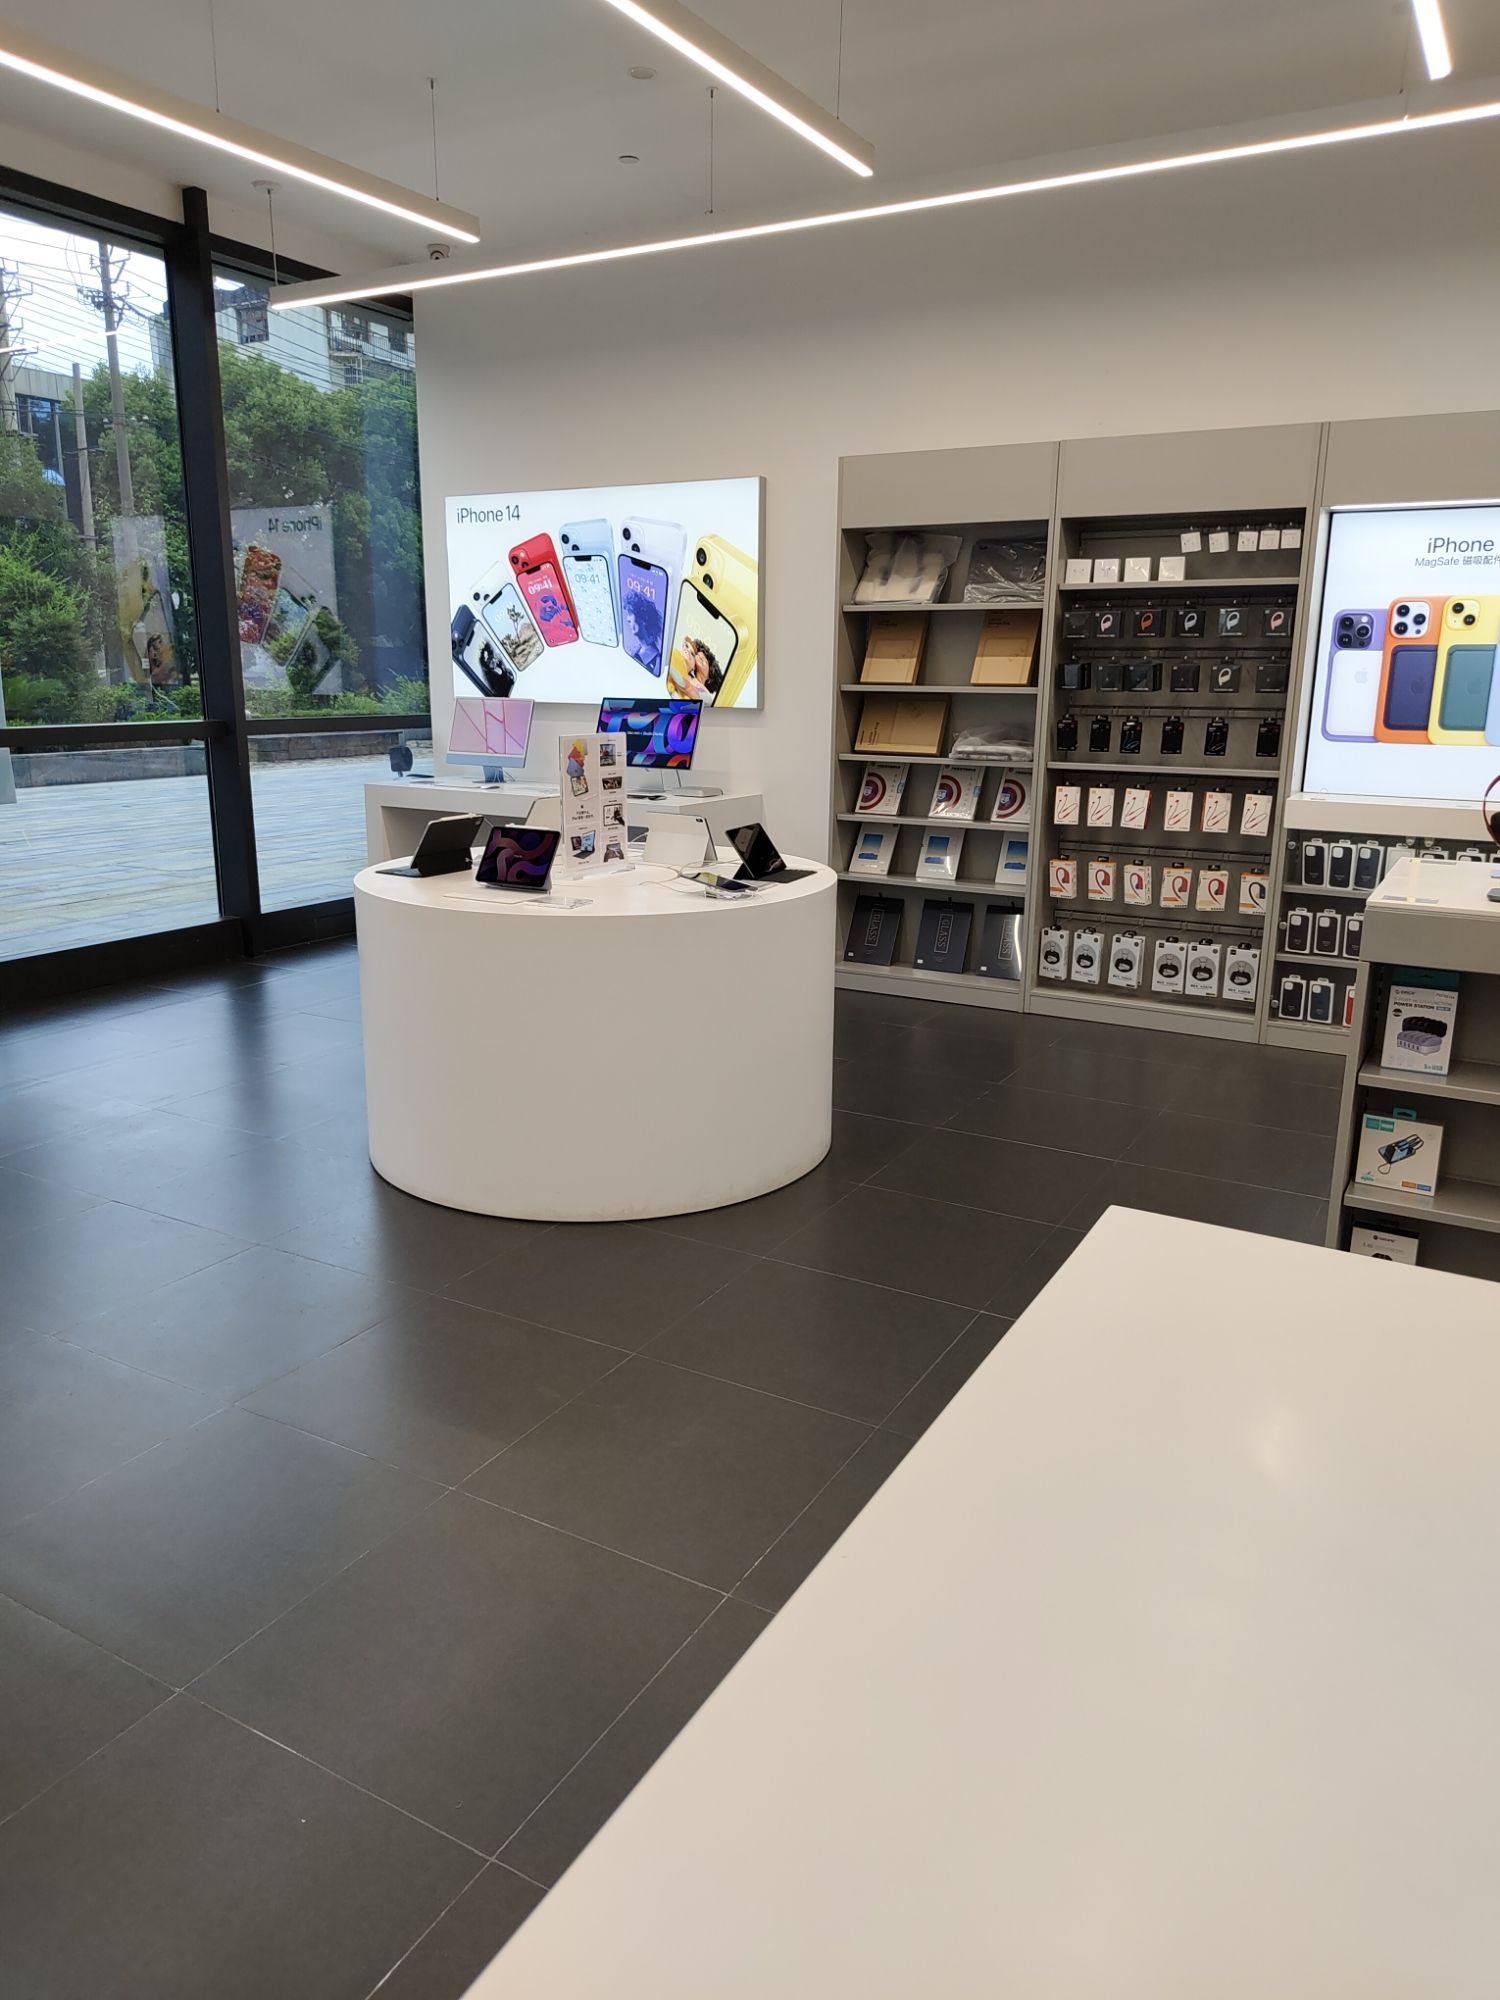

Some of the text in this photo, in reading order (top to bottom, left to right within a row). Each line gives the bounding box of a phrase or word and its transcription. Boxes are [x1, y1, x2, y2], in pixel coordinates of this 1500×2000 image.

[457, 504, 520, 524] iPhone 14
[1427, 537, 1495, 553] iPhone
[1415, 556, 1460, 568] MagSafe
[528, 578, 553, 595] 09:41
[575, 573, 601, 584] 09:41
[626, 577, 656, 601] 09:41
[868, 912, 881, 942] GLASS
[938, 917, 950, 948] GLASS
